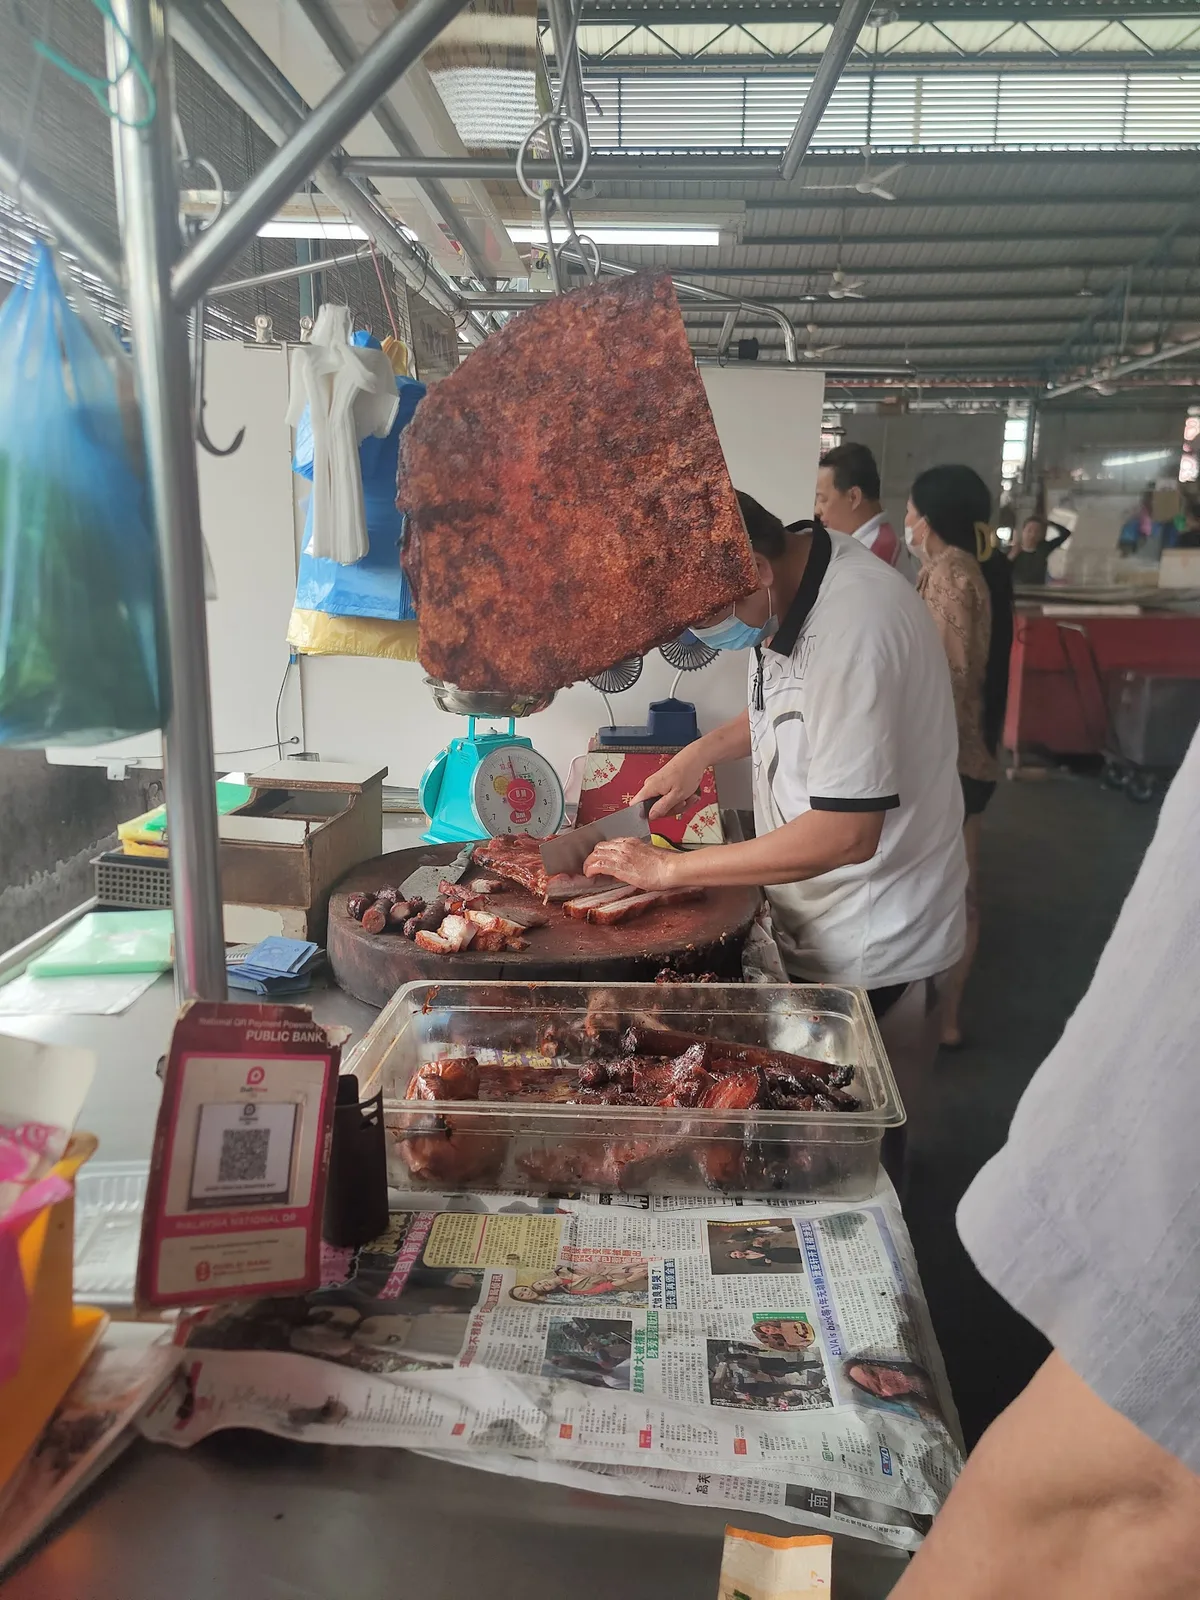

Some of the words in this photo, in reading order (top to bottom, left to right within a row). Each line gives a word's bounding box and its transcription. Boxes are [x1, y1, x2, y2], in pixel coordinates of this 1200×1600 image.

[234, 1018, 246, 1027] QR
[248, 1019, 282, 1028] Payment
[246, 1030, 289, 1042] PUBLIC
[292, 1031, 324, 1042] BANK
[176, 1218, 227, 1229] MALAYSIA
[231, 1214, 280, 1225] NATIONAL
[829, 1338, 842, 1356] ELVA
